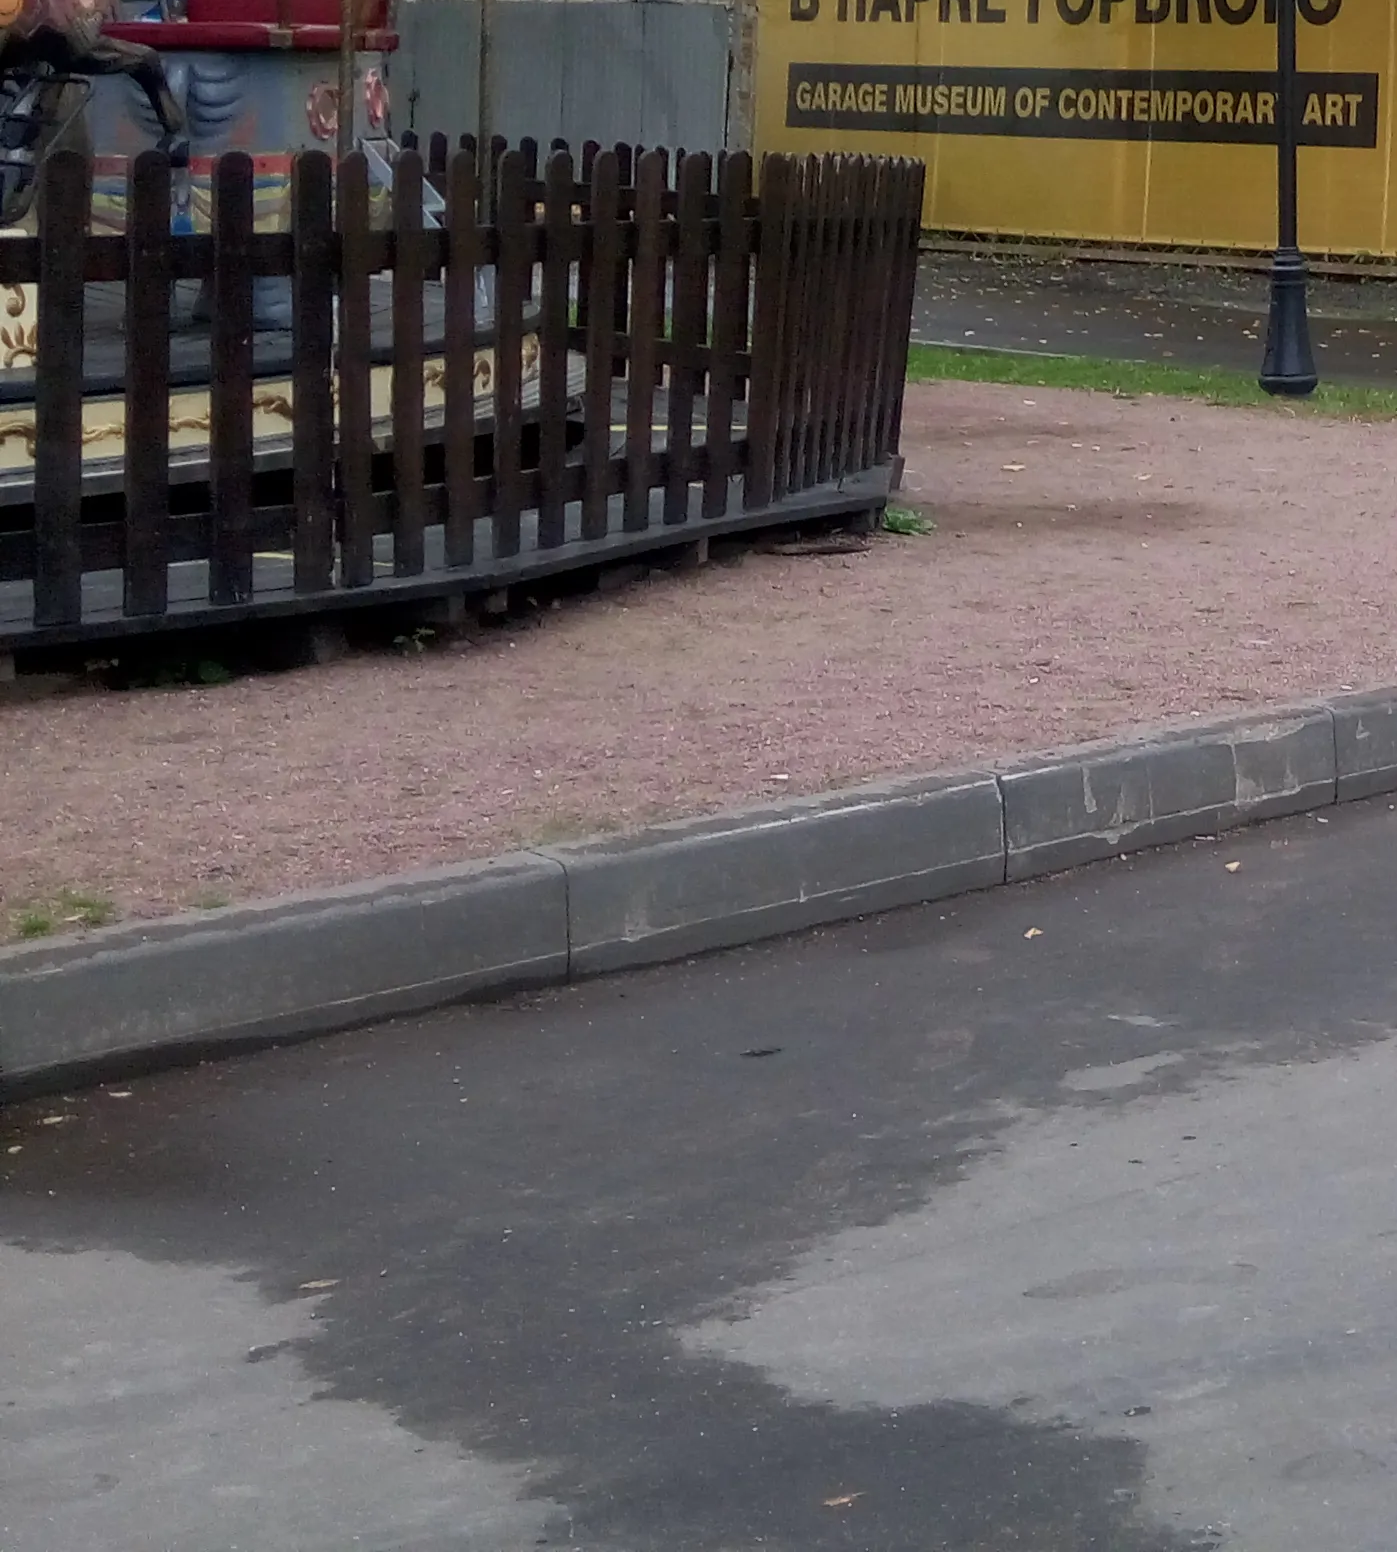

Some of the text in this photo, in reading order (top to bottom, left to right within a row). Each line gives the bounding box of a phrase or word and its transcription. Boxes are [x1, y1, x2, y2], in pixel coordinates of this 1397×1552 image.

[796, 81, 1363, 127] GARAGE MUSEUM OF CONTEMPORAR ART
